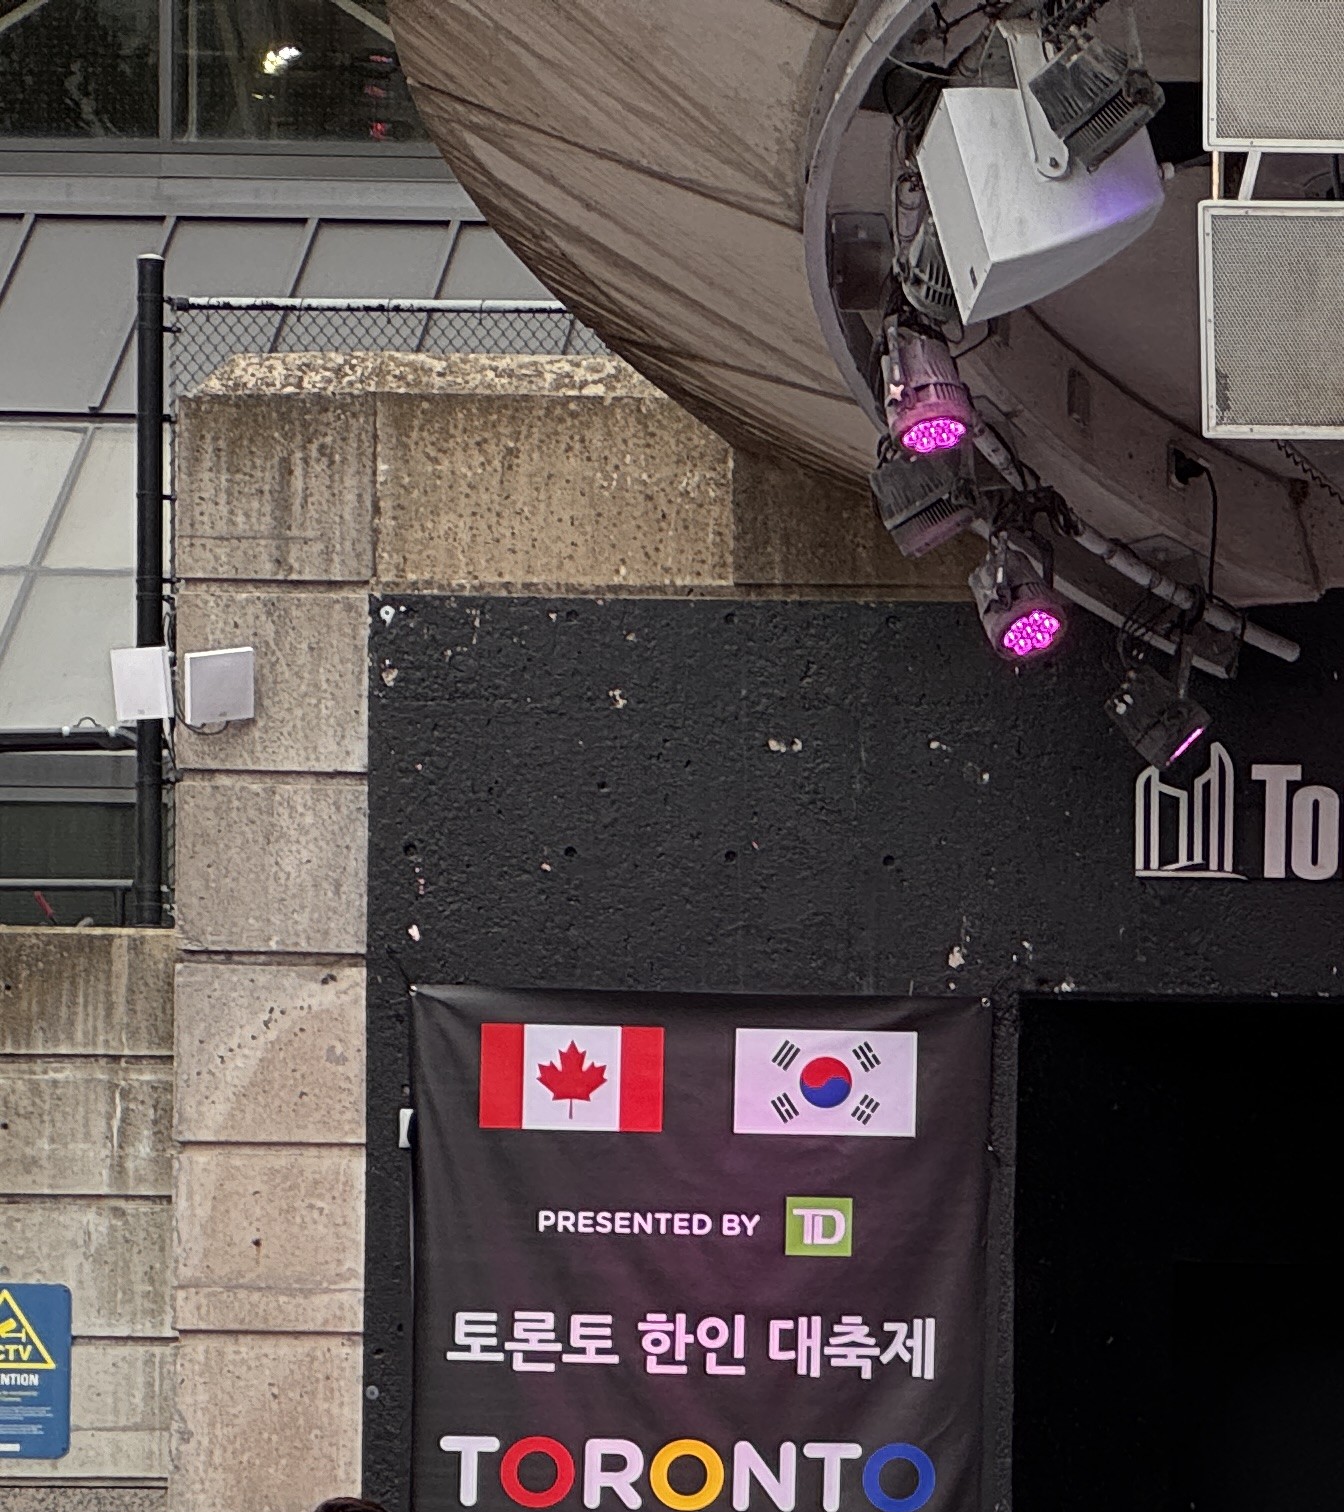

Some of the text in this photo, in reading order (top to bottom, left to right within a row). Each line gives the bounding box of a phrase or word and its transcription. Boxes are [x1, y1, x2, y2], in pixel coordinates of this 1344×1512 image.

[538, 1208, 846, 1245] PRESENTED BY TD
[446, 1311, 936, 1380] 토론토 한인 대축제
